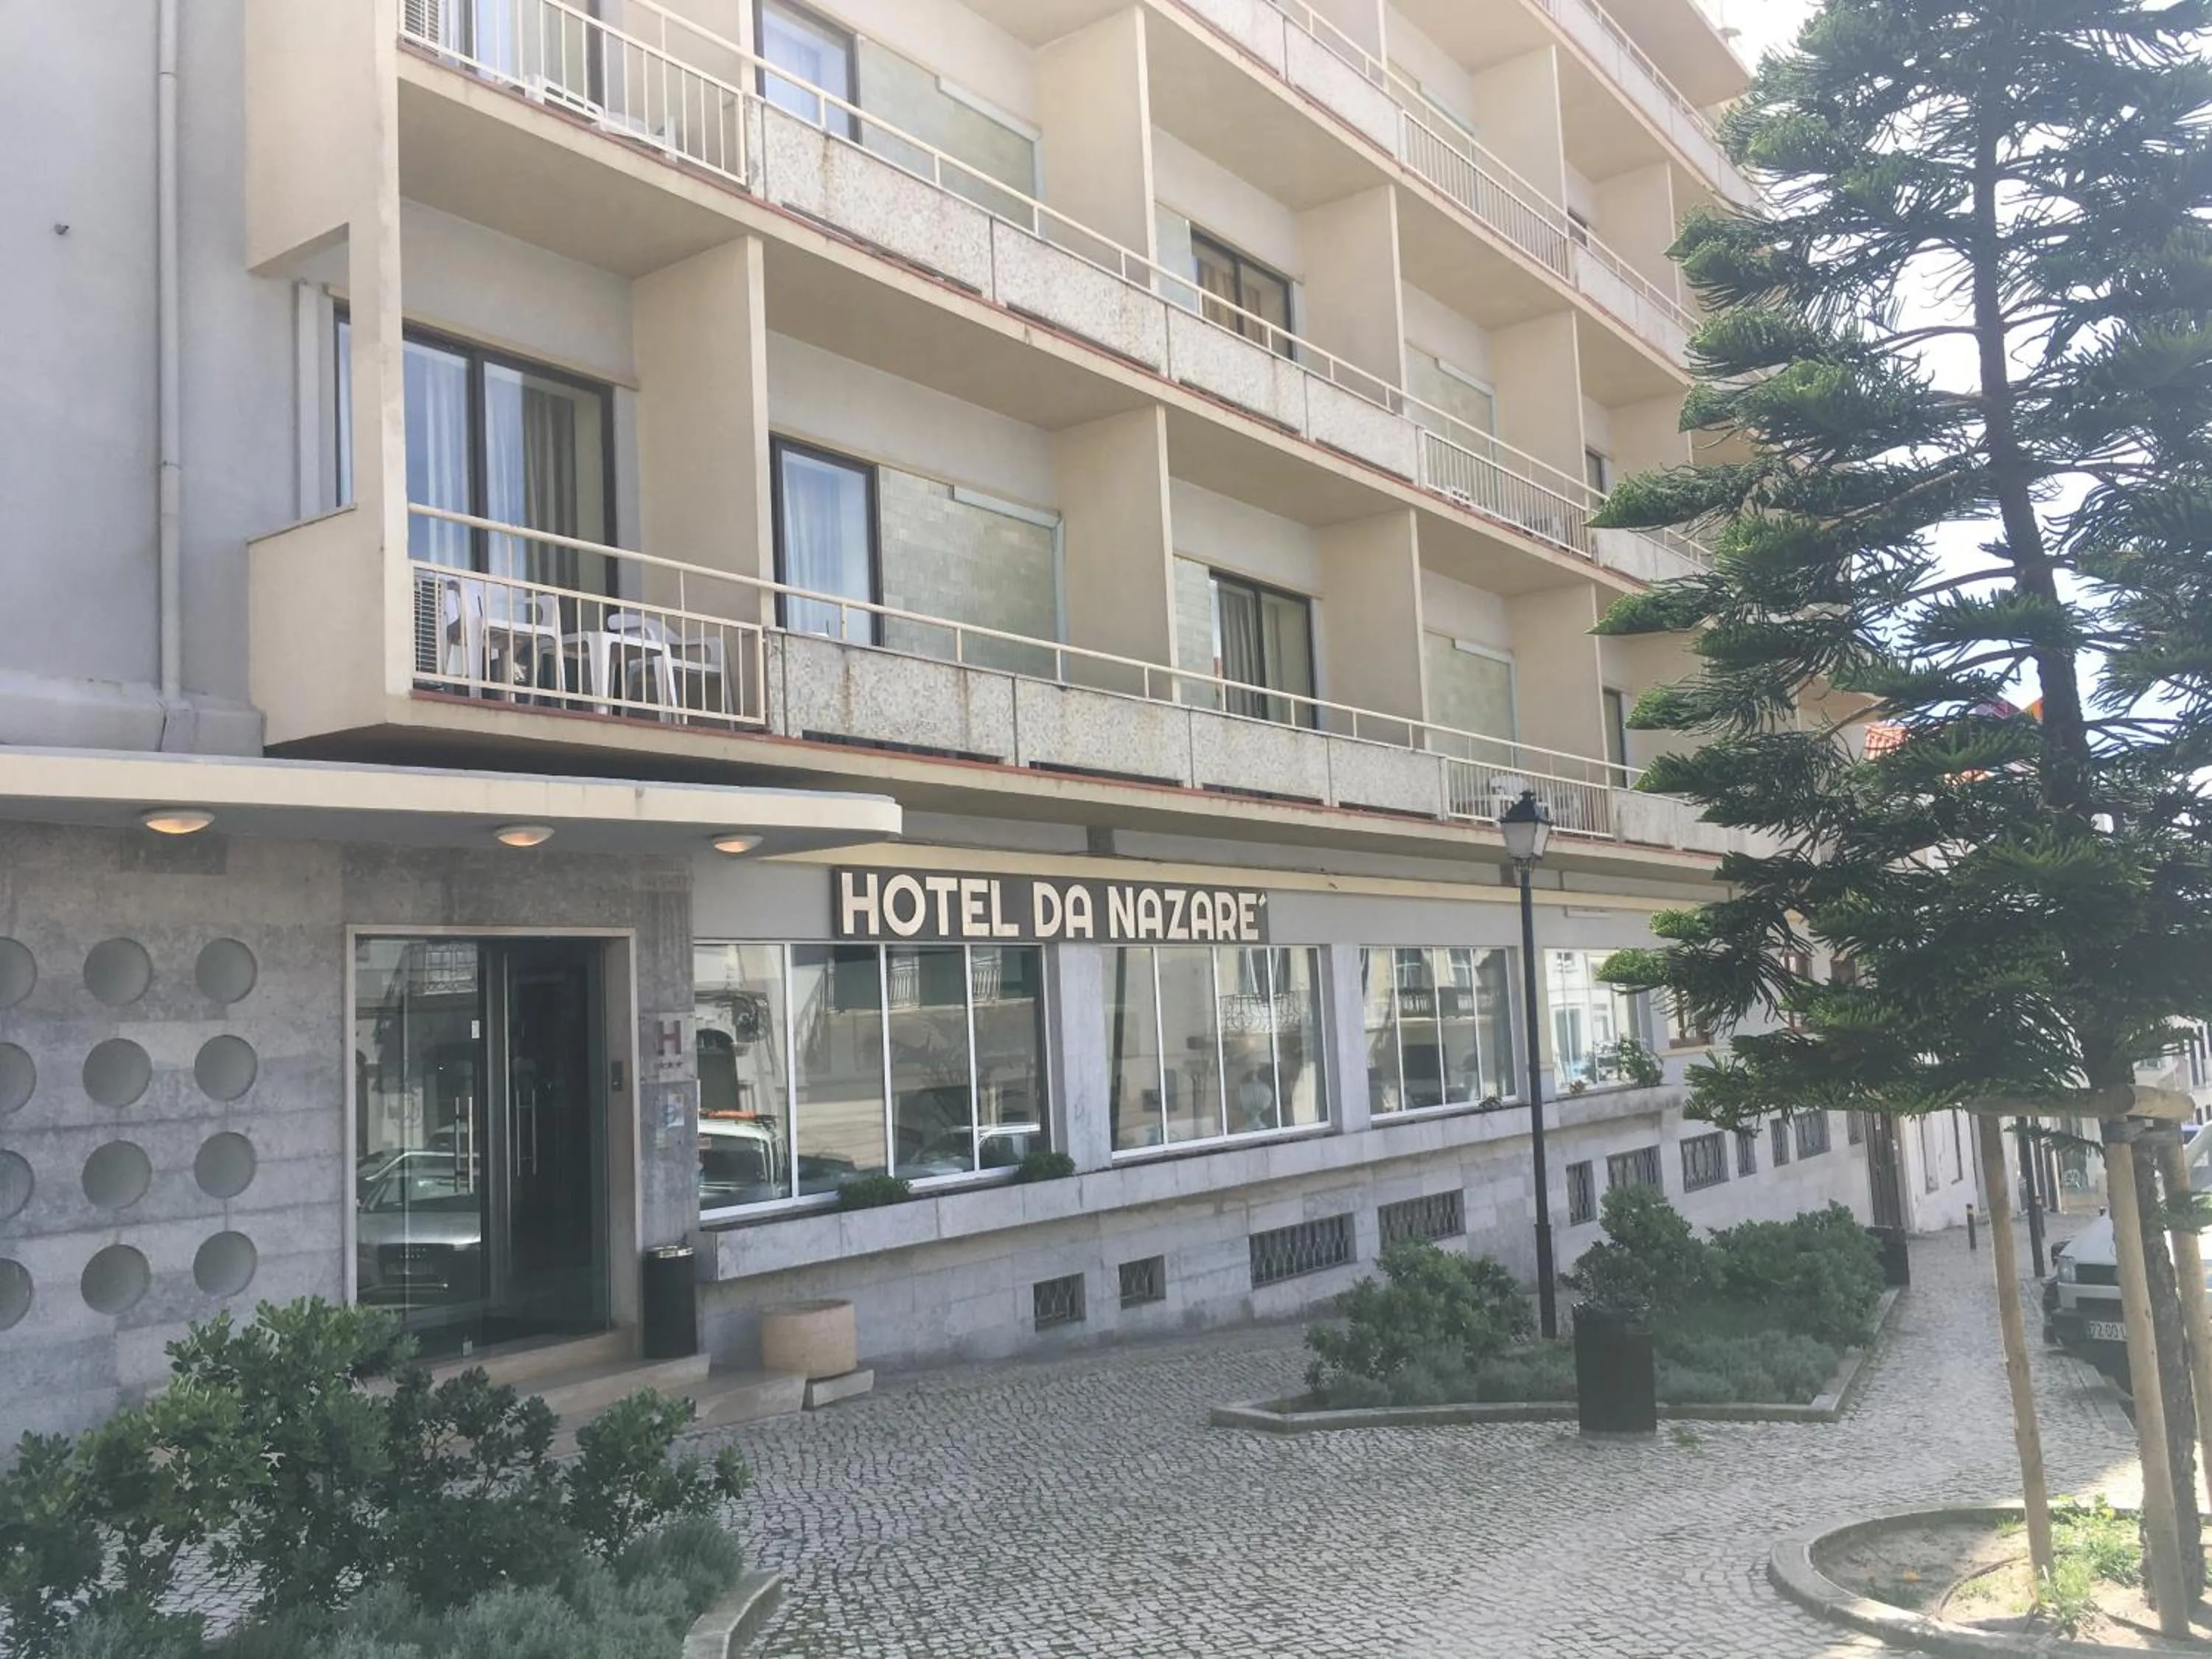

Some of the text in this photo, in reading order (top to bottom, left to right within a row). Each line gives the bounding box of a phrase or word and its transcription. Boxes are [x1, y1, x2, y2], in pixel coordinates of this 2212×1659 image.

[841, 872, 1020, 936] HOTEL
[1032, 881, 1093, 939] DA
[657, 1020, 682, 1055] H
